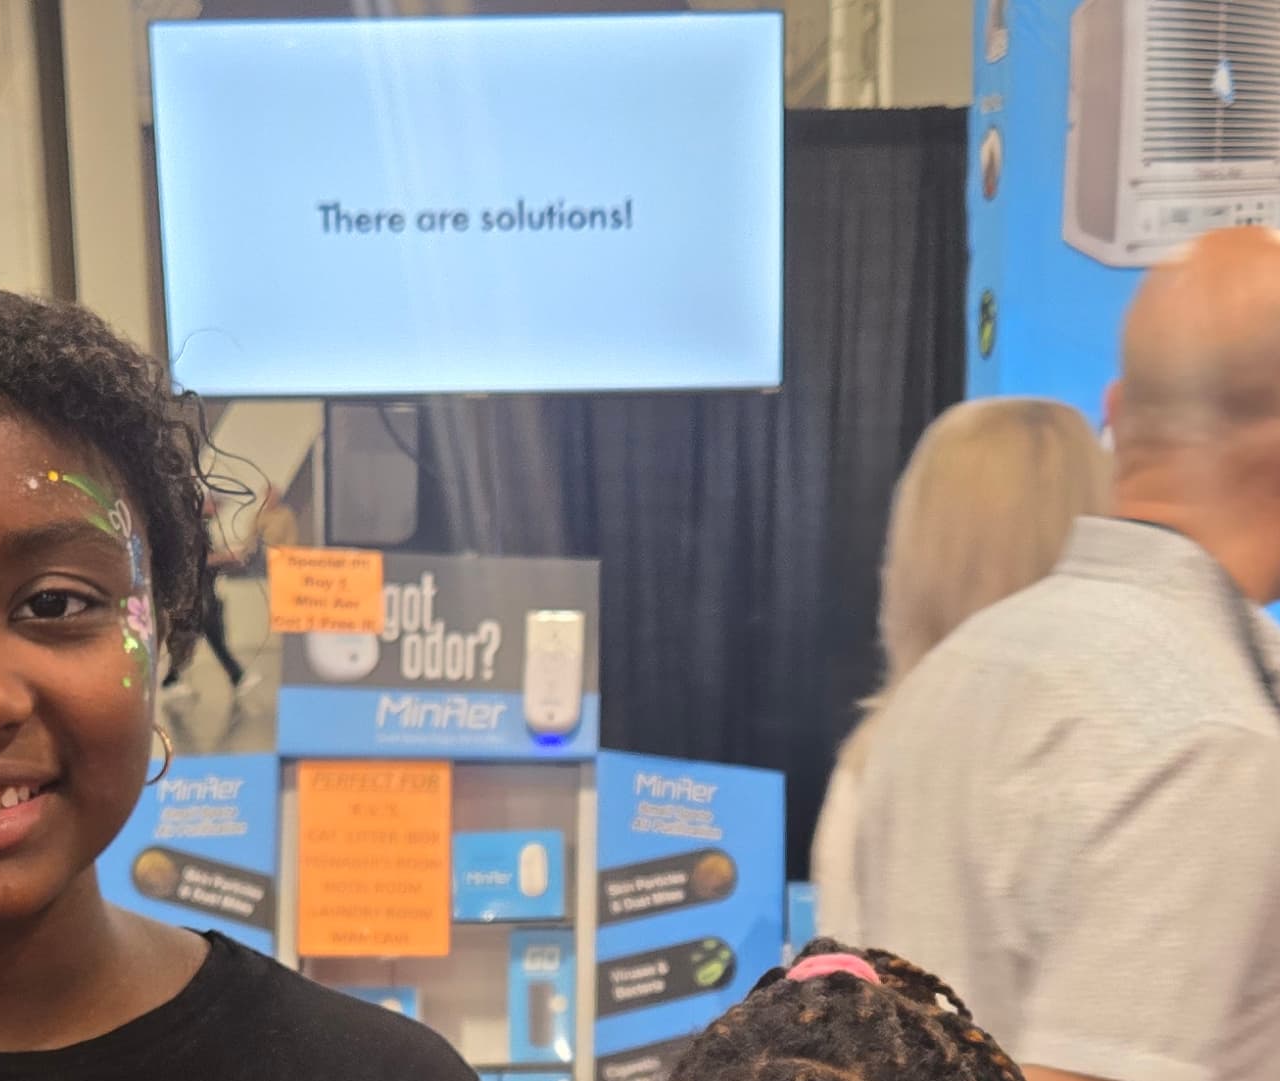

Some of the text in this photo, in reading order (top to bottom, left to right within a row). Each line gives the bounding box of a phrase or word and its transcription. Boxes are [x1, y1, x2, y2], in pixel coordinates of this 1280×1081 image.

[317, 199, 634, 233] There are solutions!
[382, 571, 437, 643] got
[400, 619, 502, 680] odor?
[376, 694, 508, 729] MinAer
[634, 772, 719, 803] MinAer
